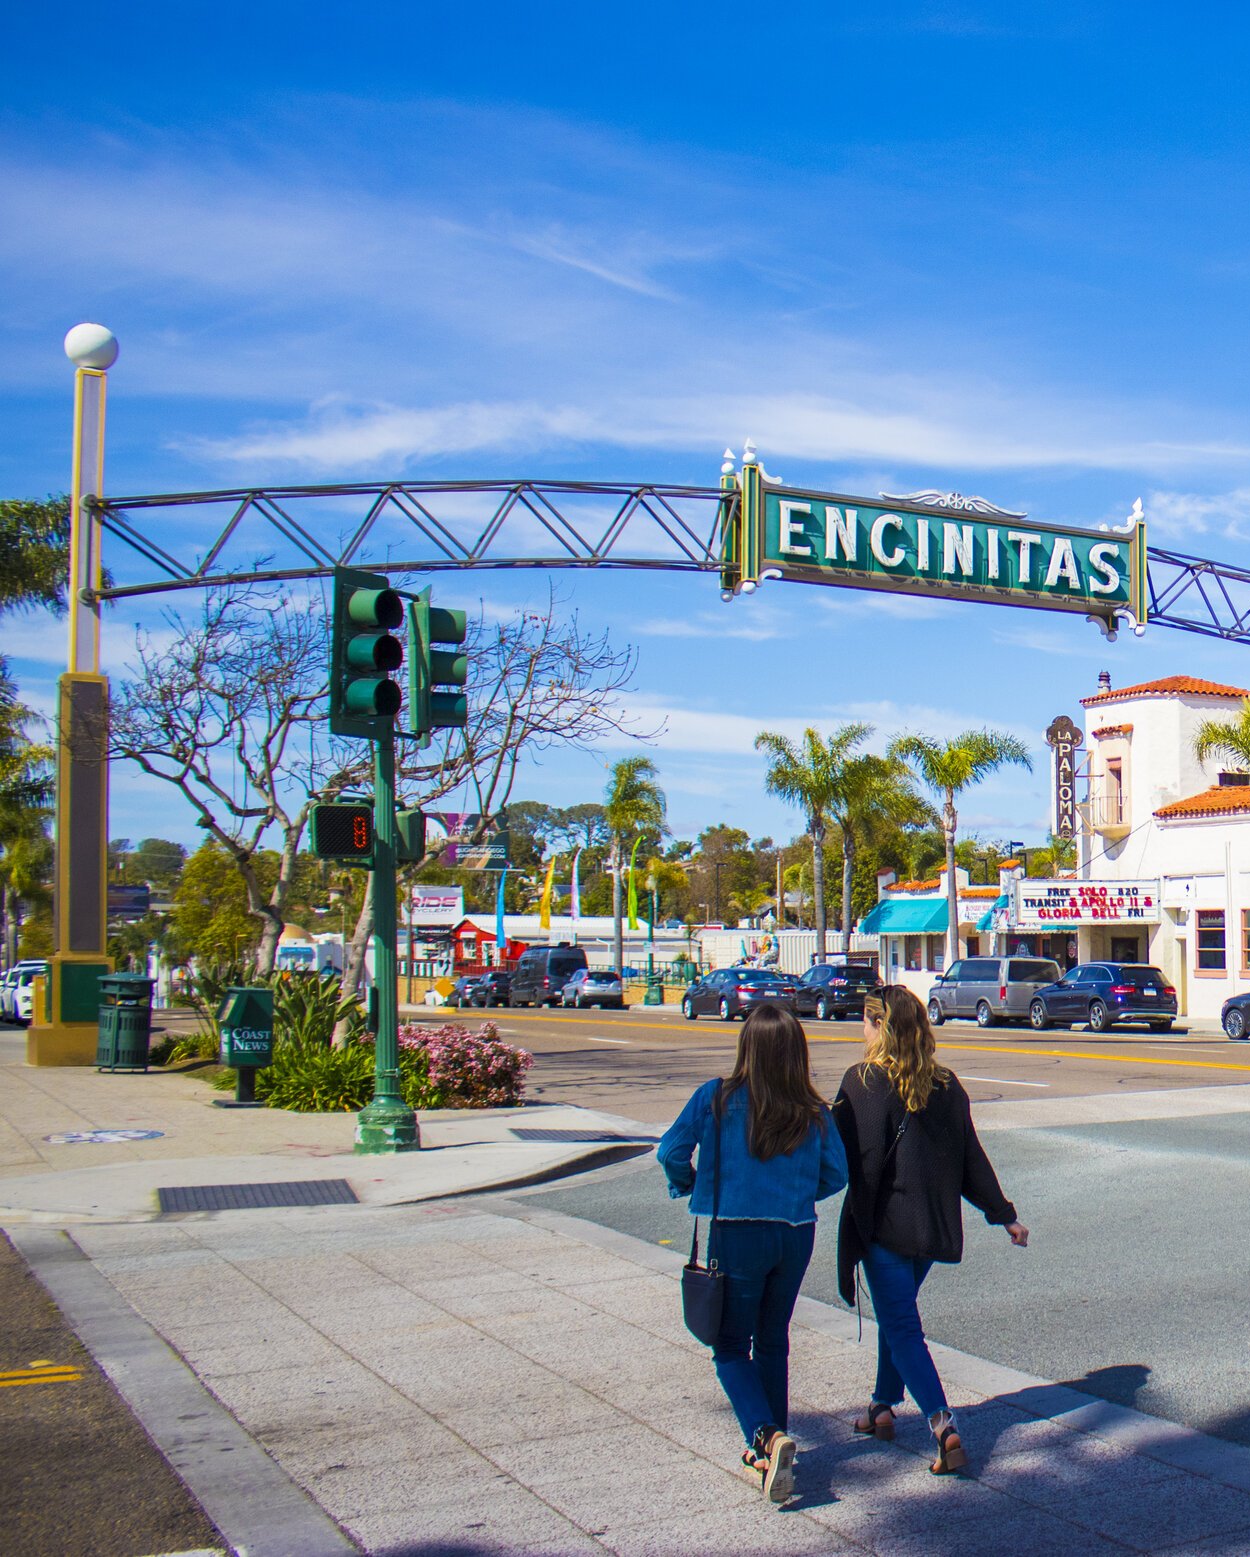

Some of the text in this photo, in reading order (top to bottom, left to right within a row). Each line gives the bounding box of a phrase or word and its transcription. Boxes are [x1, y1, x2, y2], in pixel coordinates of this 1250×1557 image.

[778, 499, 1121, 594] ENCINITAS
[1057, 731, 1072, 740] LA
[1058, 743, 1073, 830] PALOMA
[1047, 886, 1139, 897] FREE SOLO 820
[411, 896, 458, 908] RIDE
[1023, 898, 1067, 908] TRANSIT
[1081, 897, 1124, 908] APOLLO
[1038, 907, 1144, 919] GLORIA BELL FRI
[231, 1028, 271, 1040] COAST
[233, 1039, 270, 1051] NEWS
